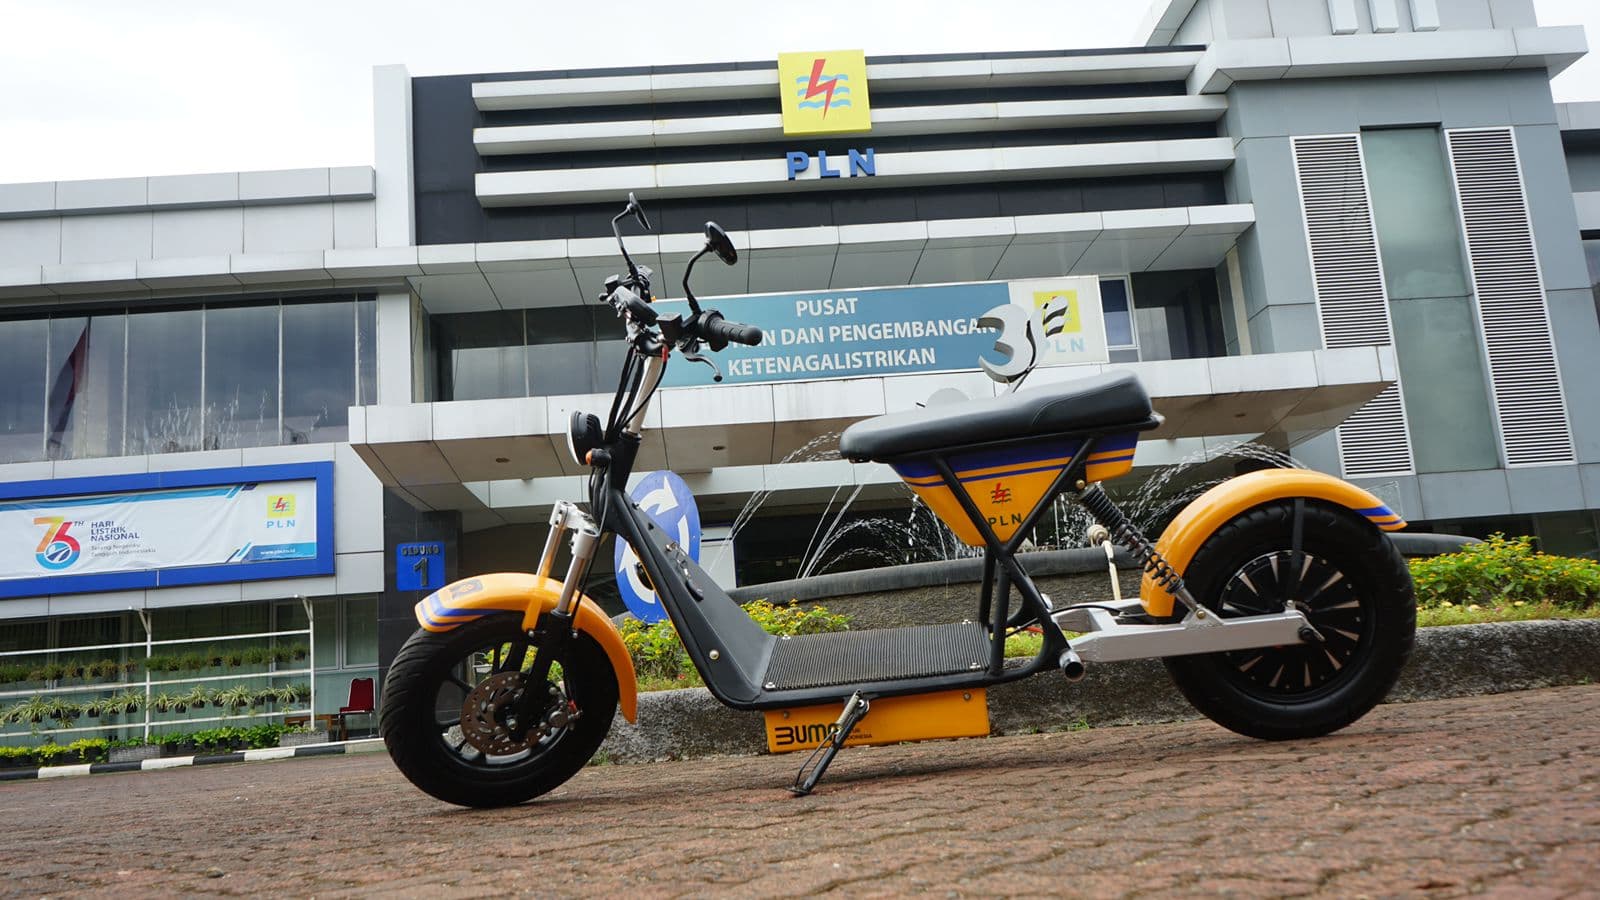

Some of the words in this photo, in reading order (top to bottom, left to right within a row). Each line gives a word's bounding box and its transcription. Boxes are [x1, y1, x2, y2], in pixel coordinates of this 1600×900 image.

[786, 148, 876, 180] PLN
[796, 297, 858, 317] PUSAT
[781, 326, 824, 346] DAN
[727, 347, 936, 376] KETENAGALISTRIKAN
[90, 520, 114, 529] HARI
[266, 519, 296, 529] PLN
[988, 511, 1022, 526] PLN
[90, 526, 126, 535] LISTRIK
[90, 532, 140, 542] NASIONAL
[32, 515, 81, 570] 76
[413, 557, 428, 588] 1
